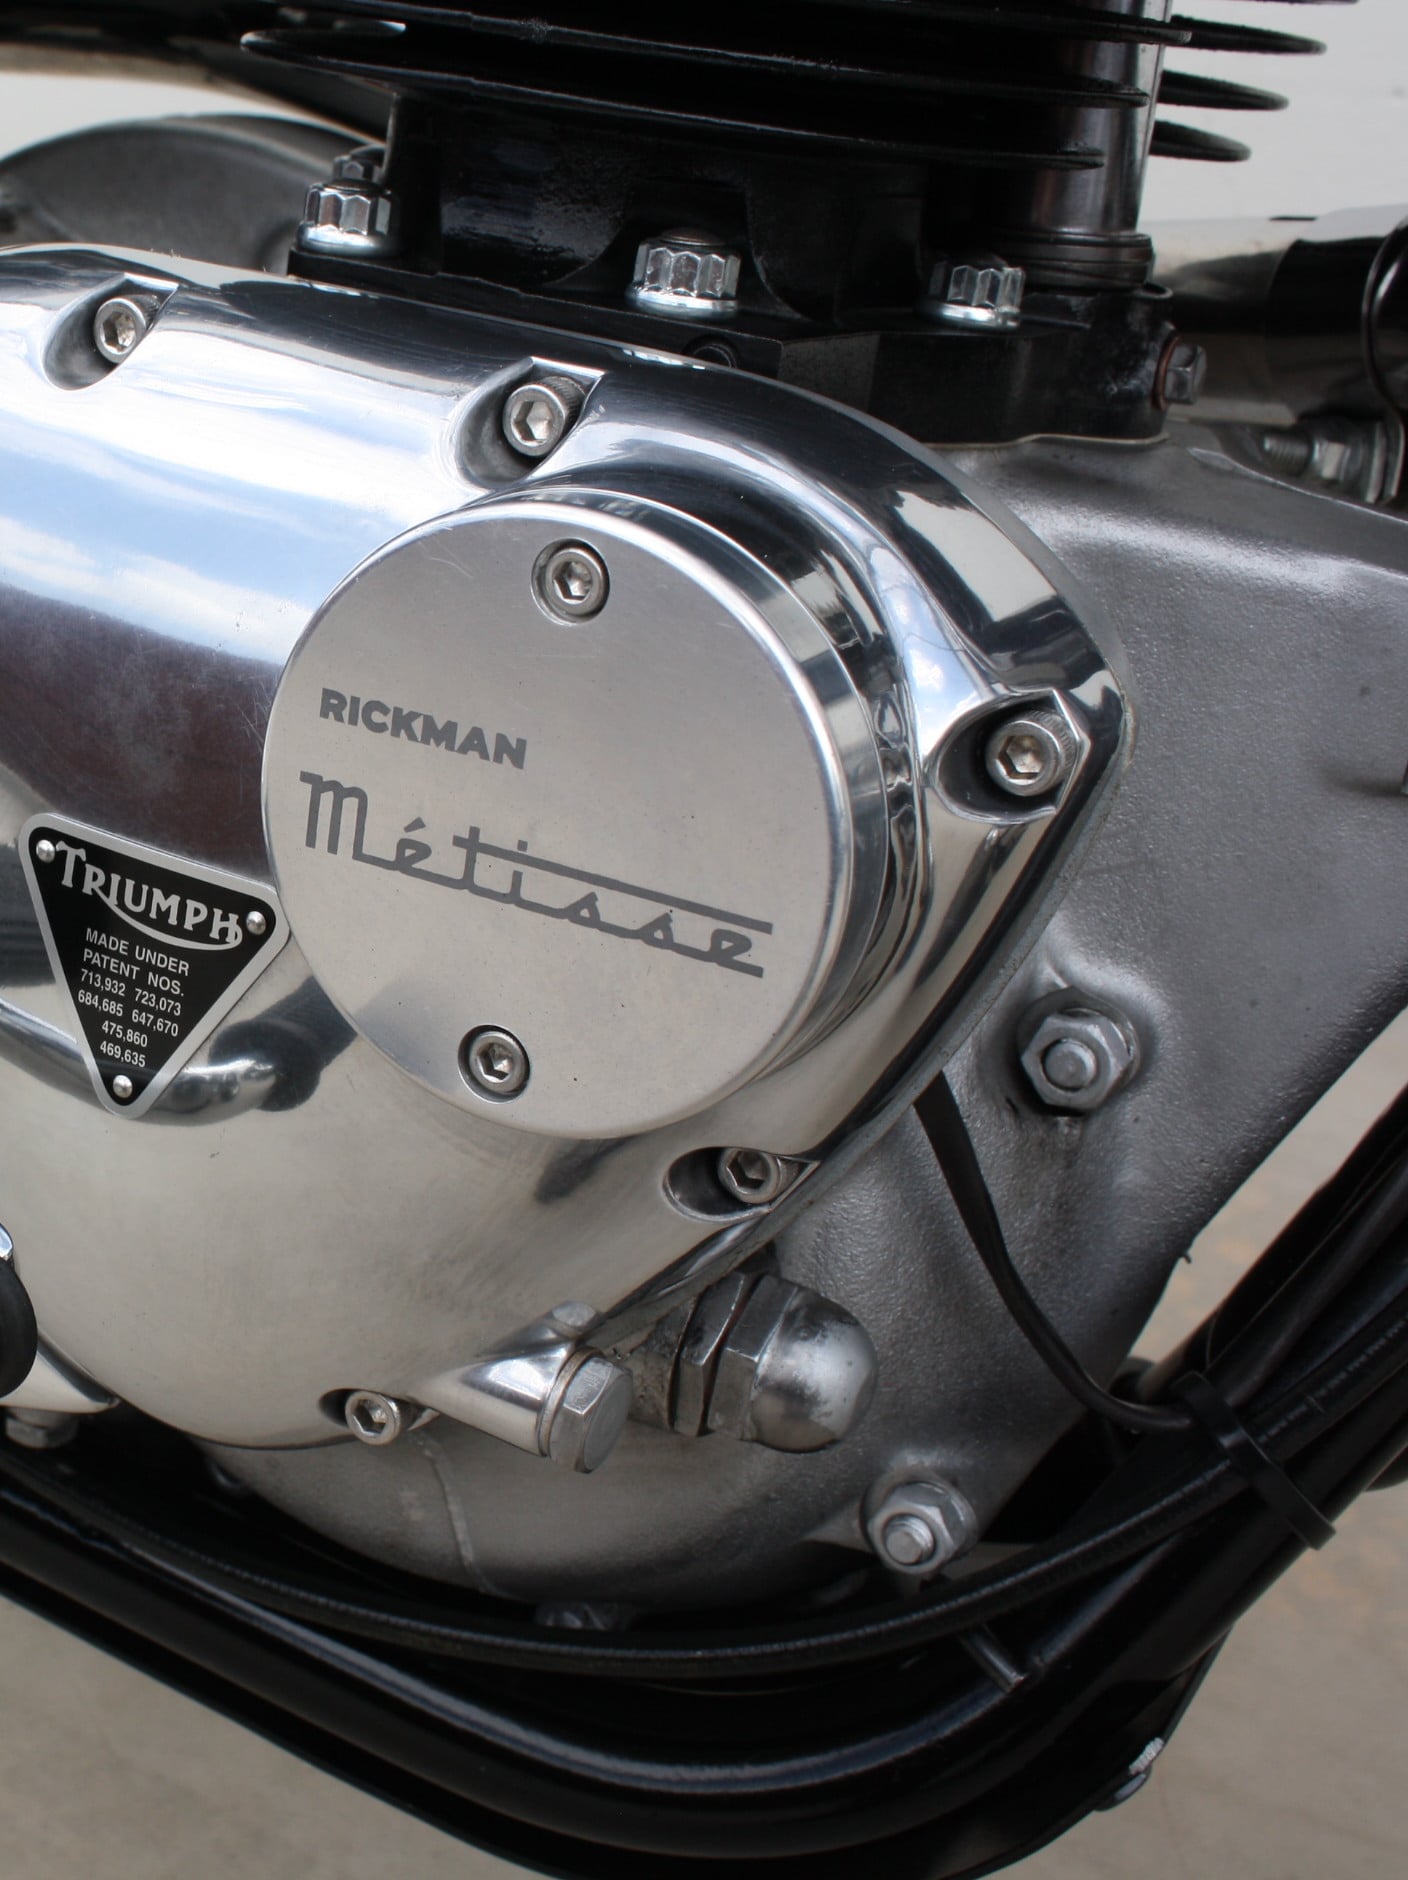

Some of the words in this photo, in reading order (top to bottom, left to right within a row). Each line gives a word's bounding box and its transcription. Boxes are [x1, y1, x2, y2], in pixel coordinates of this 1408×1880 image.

[319, 688, 527, 770] RICKMAN
[56, 840, 243, 950] TRIUMPH
[84, 949, 141, 980] PATENT
[148, 974, 184, 997] NOS.
[86, 928, 130, 954] MADE
[135, 945, 190, 976] UNDER
[78, 989, 124, 1017] 684,685
[132, 1008, 179, 1037] 647,670
[81, 969, 126, 997] 713,932
[134, 988, 182, 1016] 723,073
[100, 1040, 146, 1067] 469,635
[102, 1020, 148, 1048] 475,860
